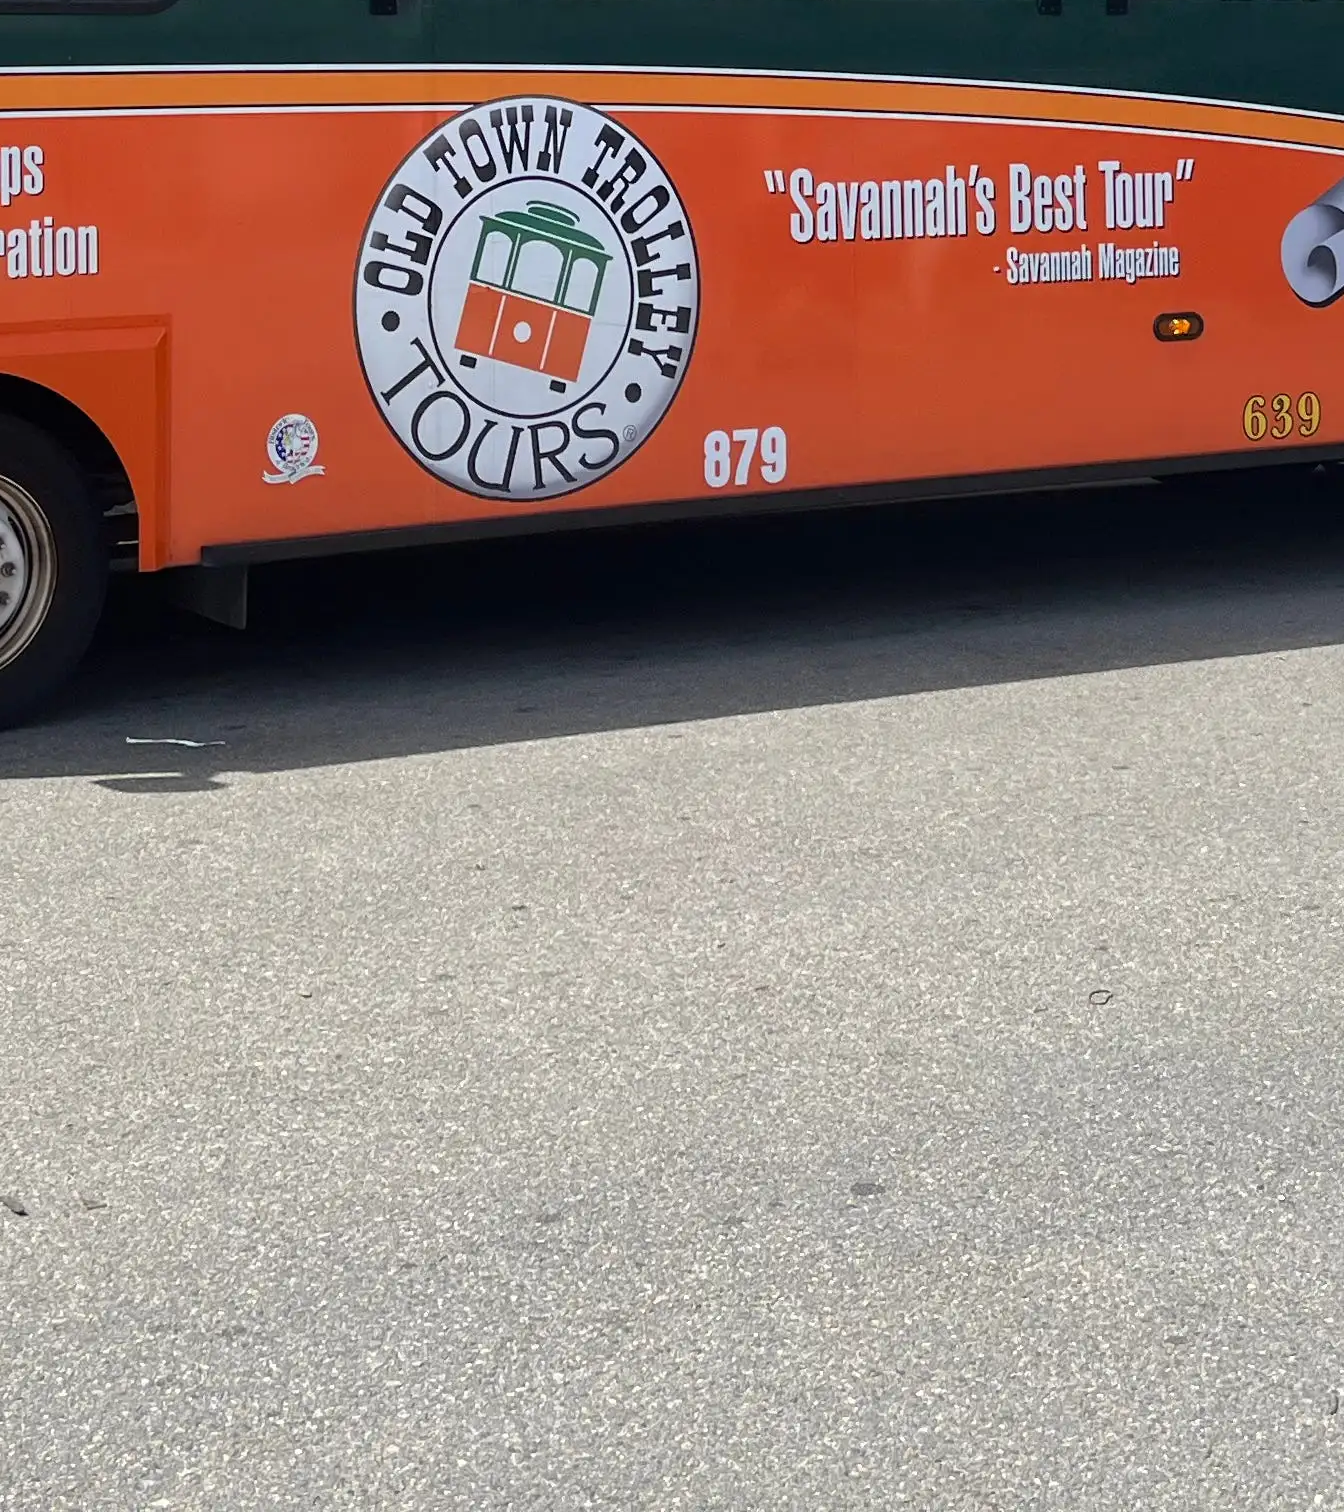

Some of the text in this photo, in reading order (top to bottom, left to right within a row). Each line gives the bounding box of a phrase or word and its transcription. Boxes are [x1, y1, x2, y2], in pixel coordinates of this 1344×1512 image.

[763, 158, 1194, 244] "Savannah's Best Tour"
[363, 104, 692, 379] OLD TOWN TROLLEY
[1098, 240, 1180, 284] Magazine
[380, 337, 621, 493] TOURS
[1243, 391, 1322, 441] 639
[704, 426, 787, 488] 879
